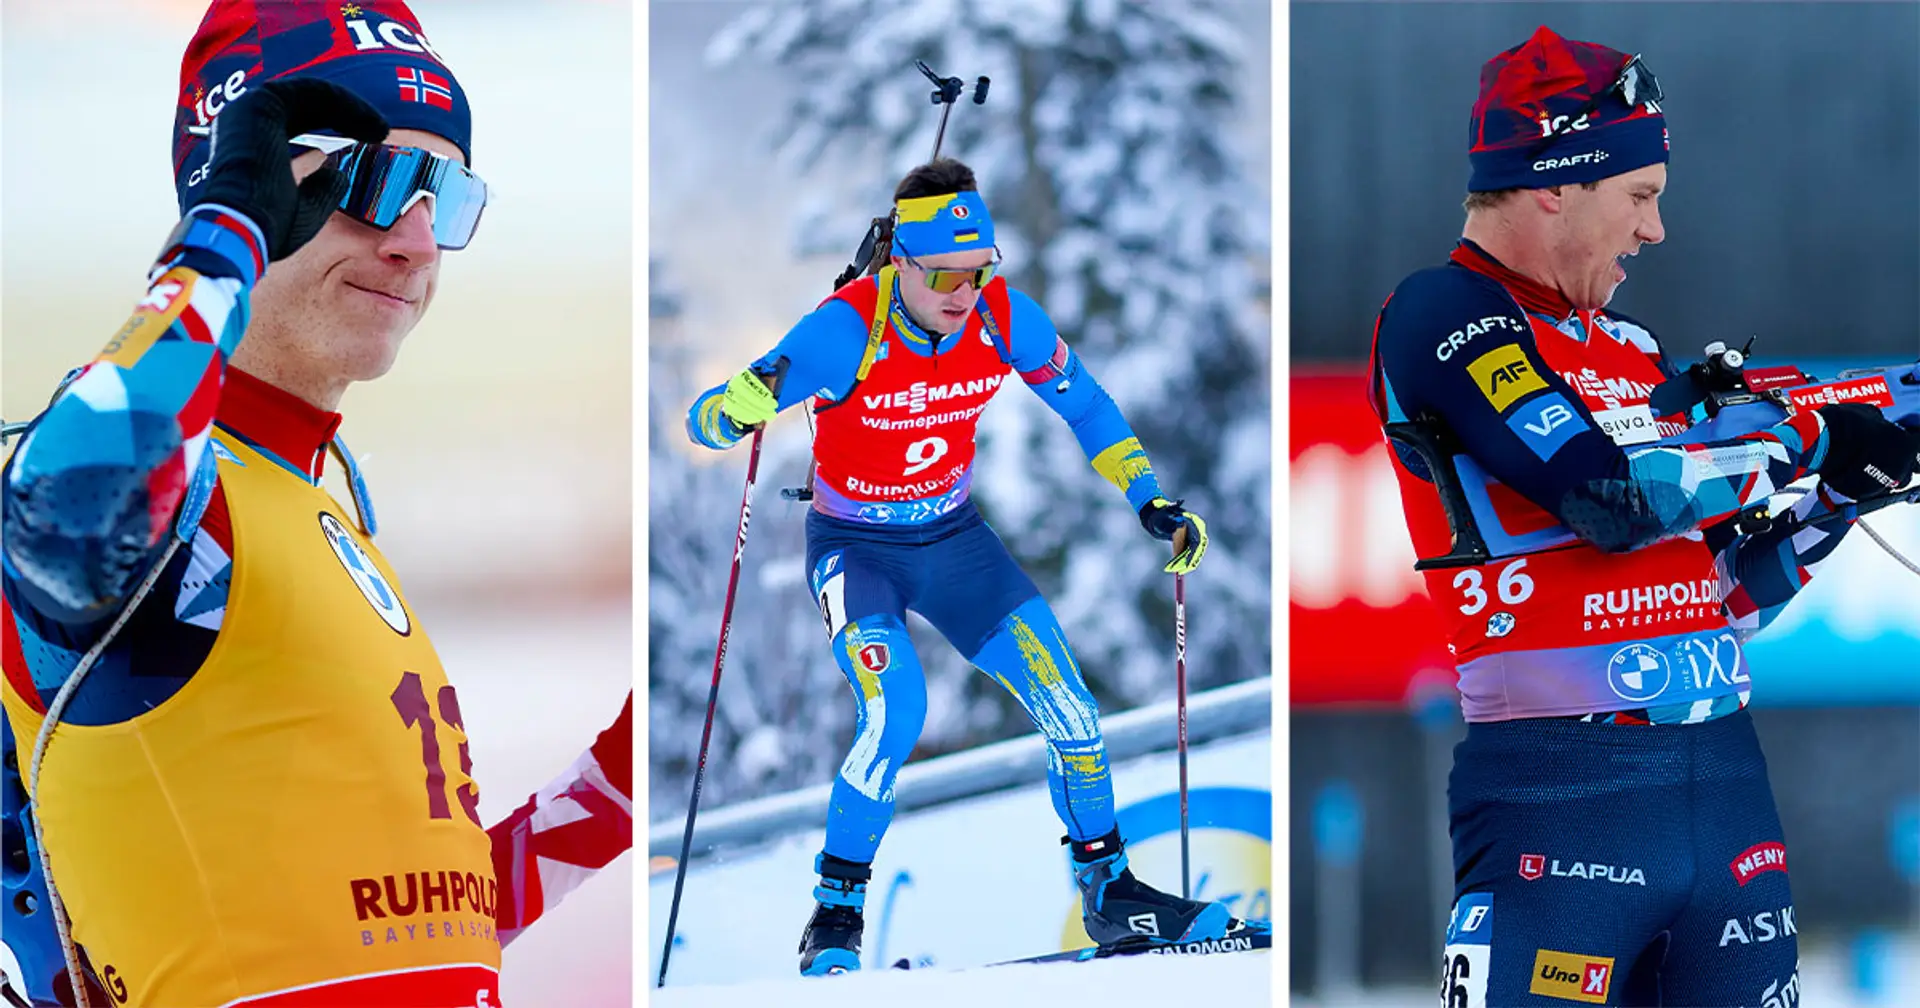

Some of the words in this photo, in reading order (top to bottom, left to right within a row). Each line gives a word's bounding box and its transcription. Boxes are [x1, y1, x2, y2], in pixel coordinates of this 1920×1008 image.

[195, 70, 247, 126] ice
[1533, 152, 1593, 171] CRAFT
[1436, 315, 1508, 362] CRAFT
[862, 374, 1002, 414] VIESSMANN
[1491, 360, 1528, 395] AF
[1524, 403, 1573, 437] VB
[902, 436, 949, 477] 9
[1452, 559, 1535, 616] 36
[1583, 607, 1704, 632] BAYERISCHE
[1550, 860, 1647, 886] LAPUA
[1737, 848, 1785, 877] MENY
